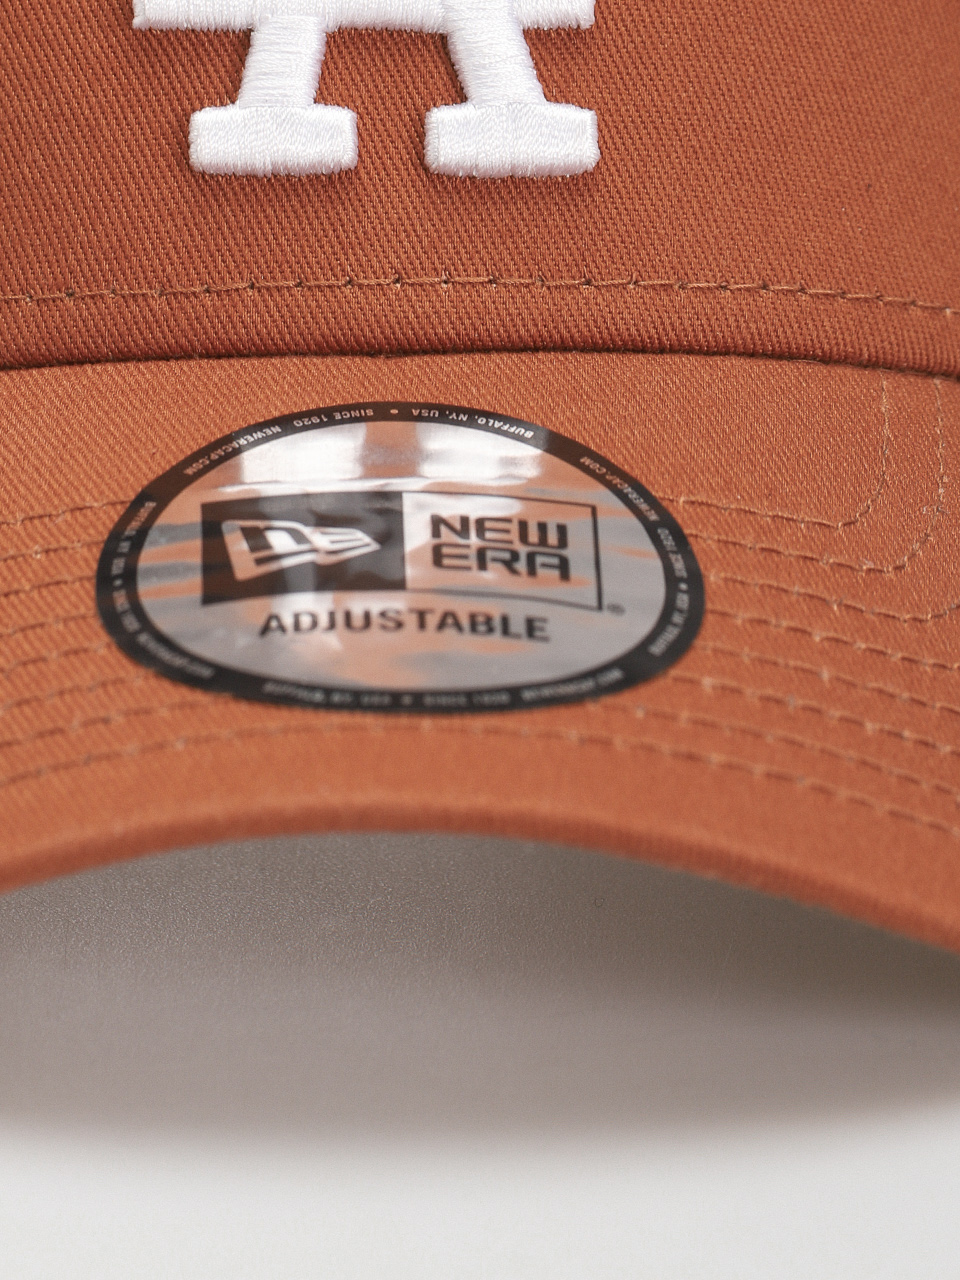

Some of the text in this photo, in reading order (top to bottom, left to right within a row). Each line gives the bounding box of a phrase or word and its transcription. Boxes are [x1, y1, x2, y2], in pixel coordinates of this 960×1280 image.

[183, 408, 535, 476] BUFFALO, NY, USA SINCE 1920 NEWERACAP.COM
[430, 513, 568, 550] NEW
[431, 543, 571, 582] ERA
[258, 607, 551, 643] ADJUSTABLE
